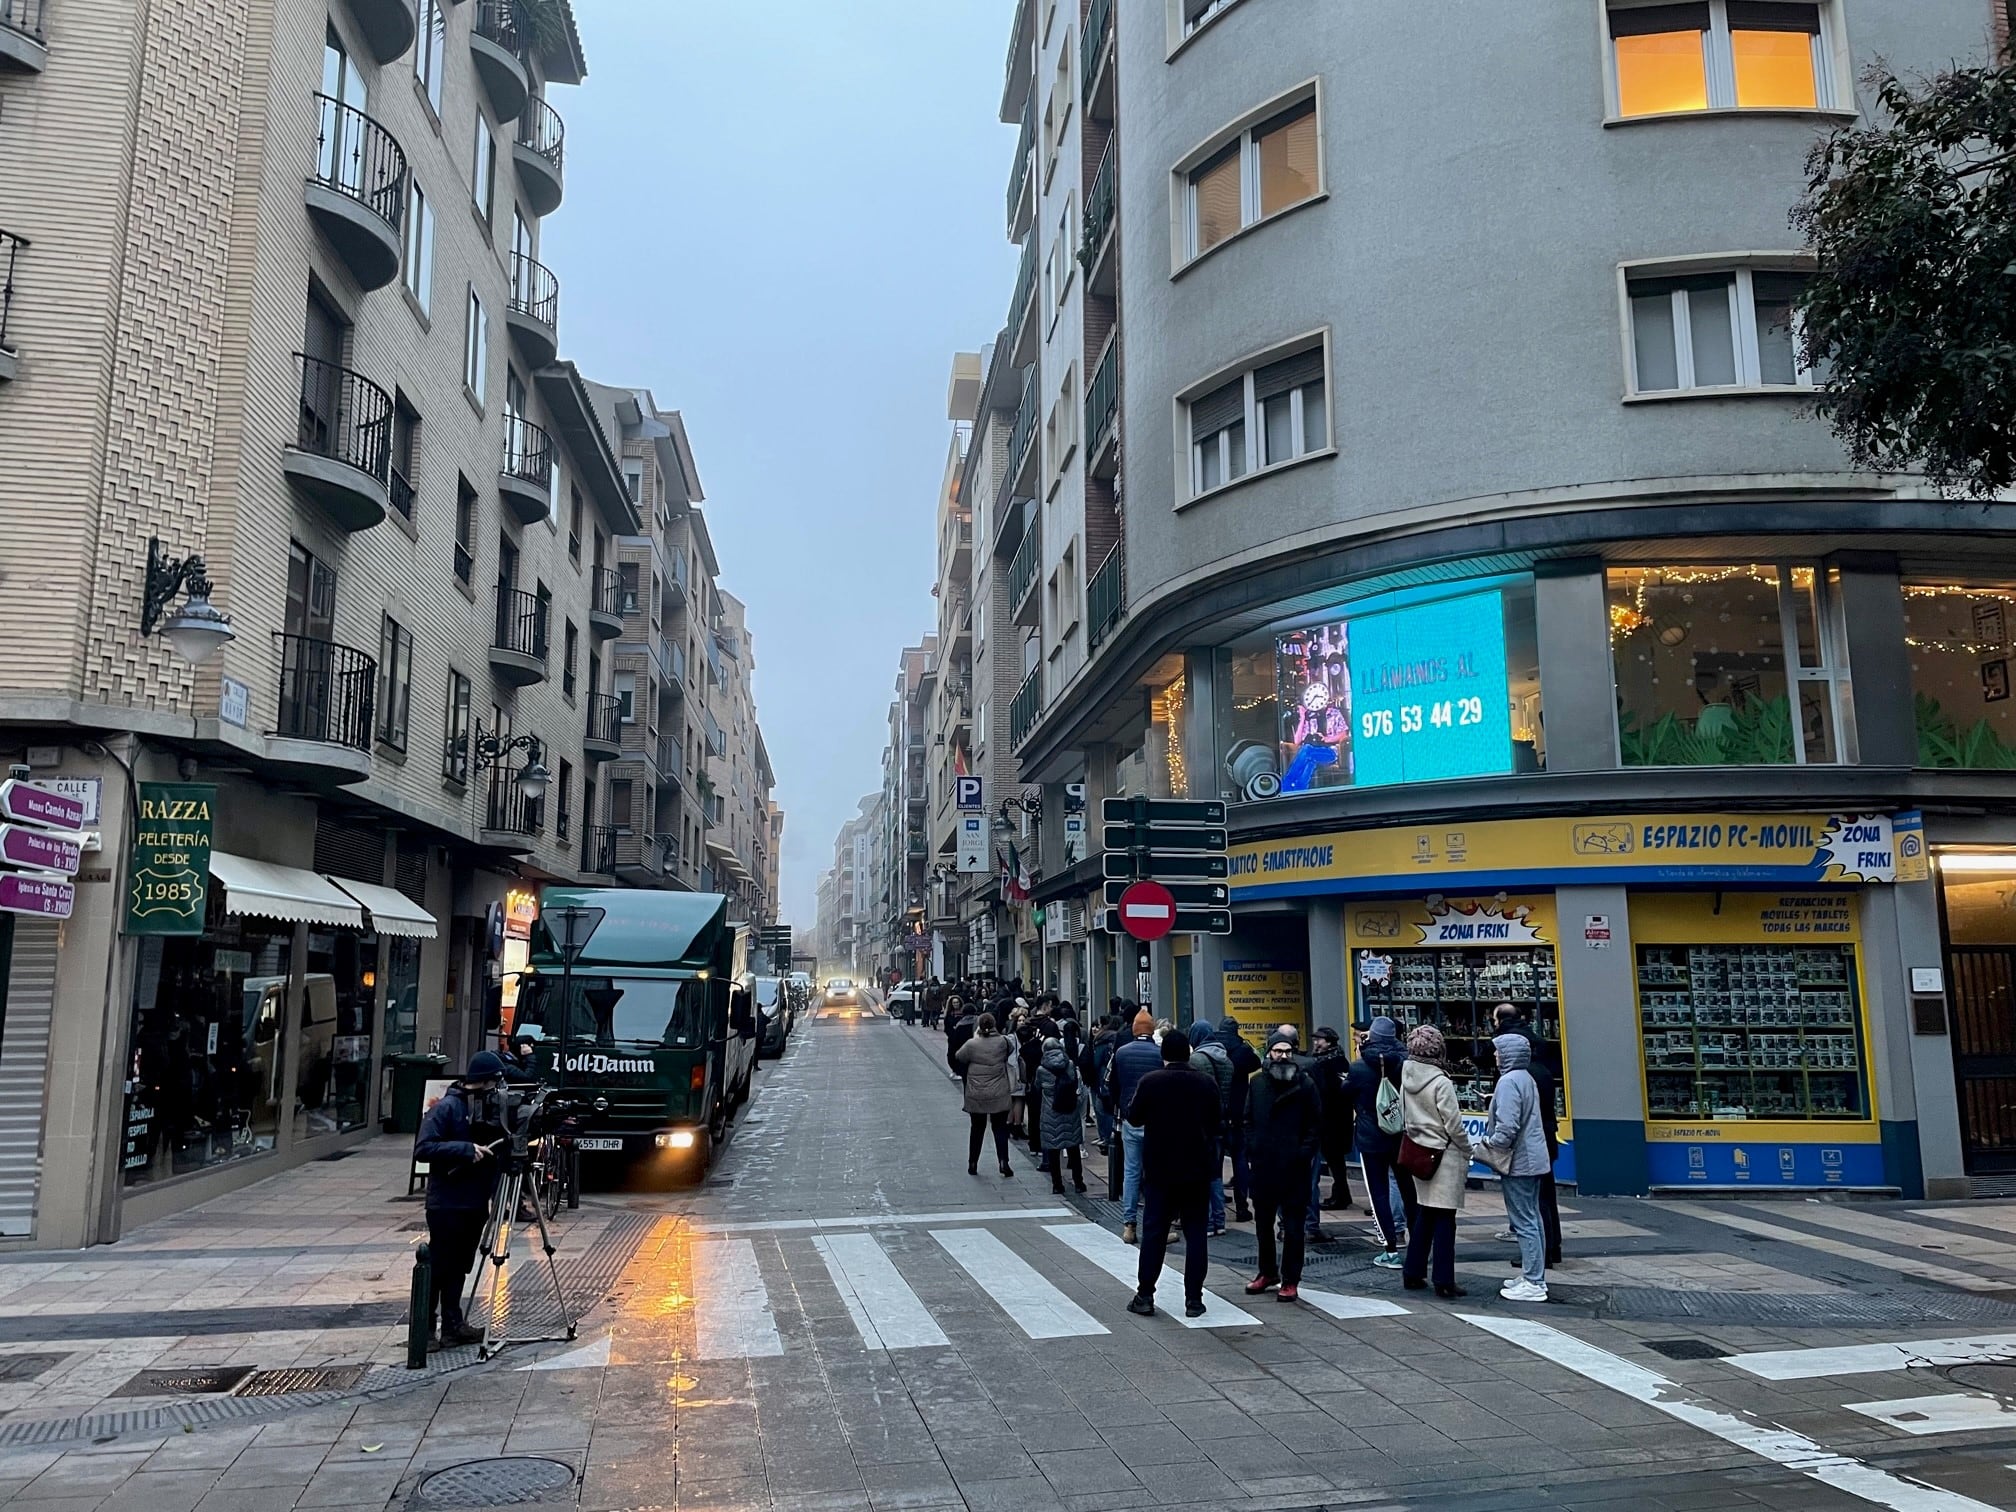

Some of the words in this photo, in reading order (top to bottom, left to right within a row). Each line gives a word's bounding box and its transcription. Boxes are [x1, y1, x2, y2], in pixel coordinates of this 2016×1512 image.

[1458, 652, 1479, 679] AL
[1362, 709, 1394, 738] 976
[1400, 704, 1423, 733] 53
[1430, 700, 1452, 728] 44
[1457, 696, 1483, 725] 29
[57, 783, 88, 792] CALLE
[960, 779, 980, 803] P
[45, 801, 65, 818] Camón
[65, 807, 82, 822] Aznar
[141, 800, 210, 820] RAZZA
[138, 829, 210, 847] PELETERÍA
[1643, 825, 1722, 849] ESPAZIO
[1727, 824, 1814, 848] PC-MOVIL
[1842, 825, 1880, 843] ZONA
[154, 853, 190, 865] DESDE
[1263, 845, 1334, 872] SMARTPHONE
[1857, 851, 1892, 868] FRIKI
[41, 883, 58, 898] Santa
[58, 886, 72, 900] Cruz
[145, 883, 191, 900] 1985
[1836, 897, 1847, 906] DE
[1803, 910, 1810, 919] Y
[1811, 910, 1849, 919] TABLETS
[1440, 924, 1473, 940] ZONA
[1477, 923, 1509, 938] FRIKI
[1762, 923, 1791, 932] TODAS
[1794, 923, 1811, 932] LAS
[1813, 922, 1851, 932] MARCAS
